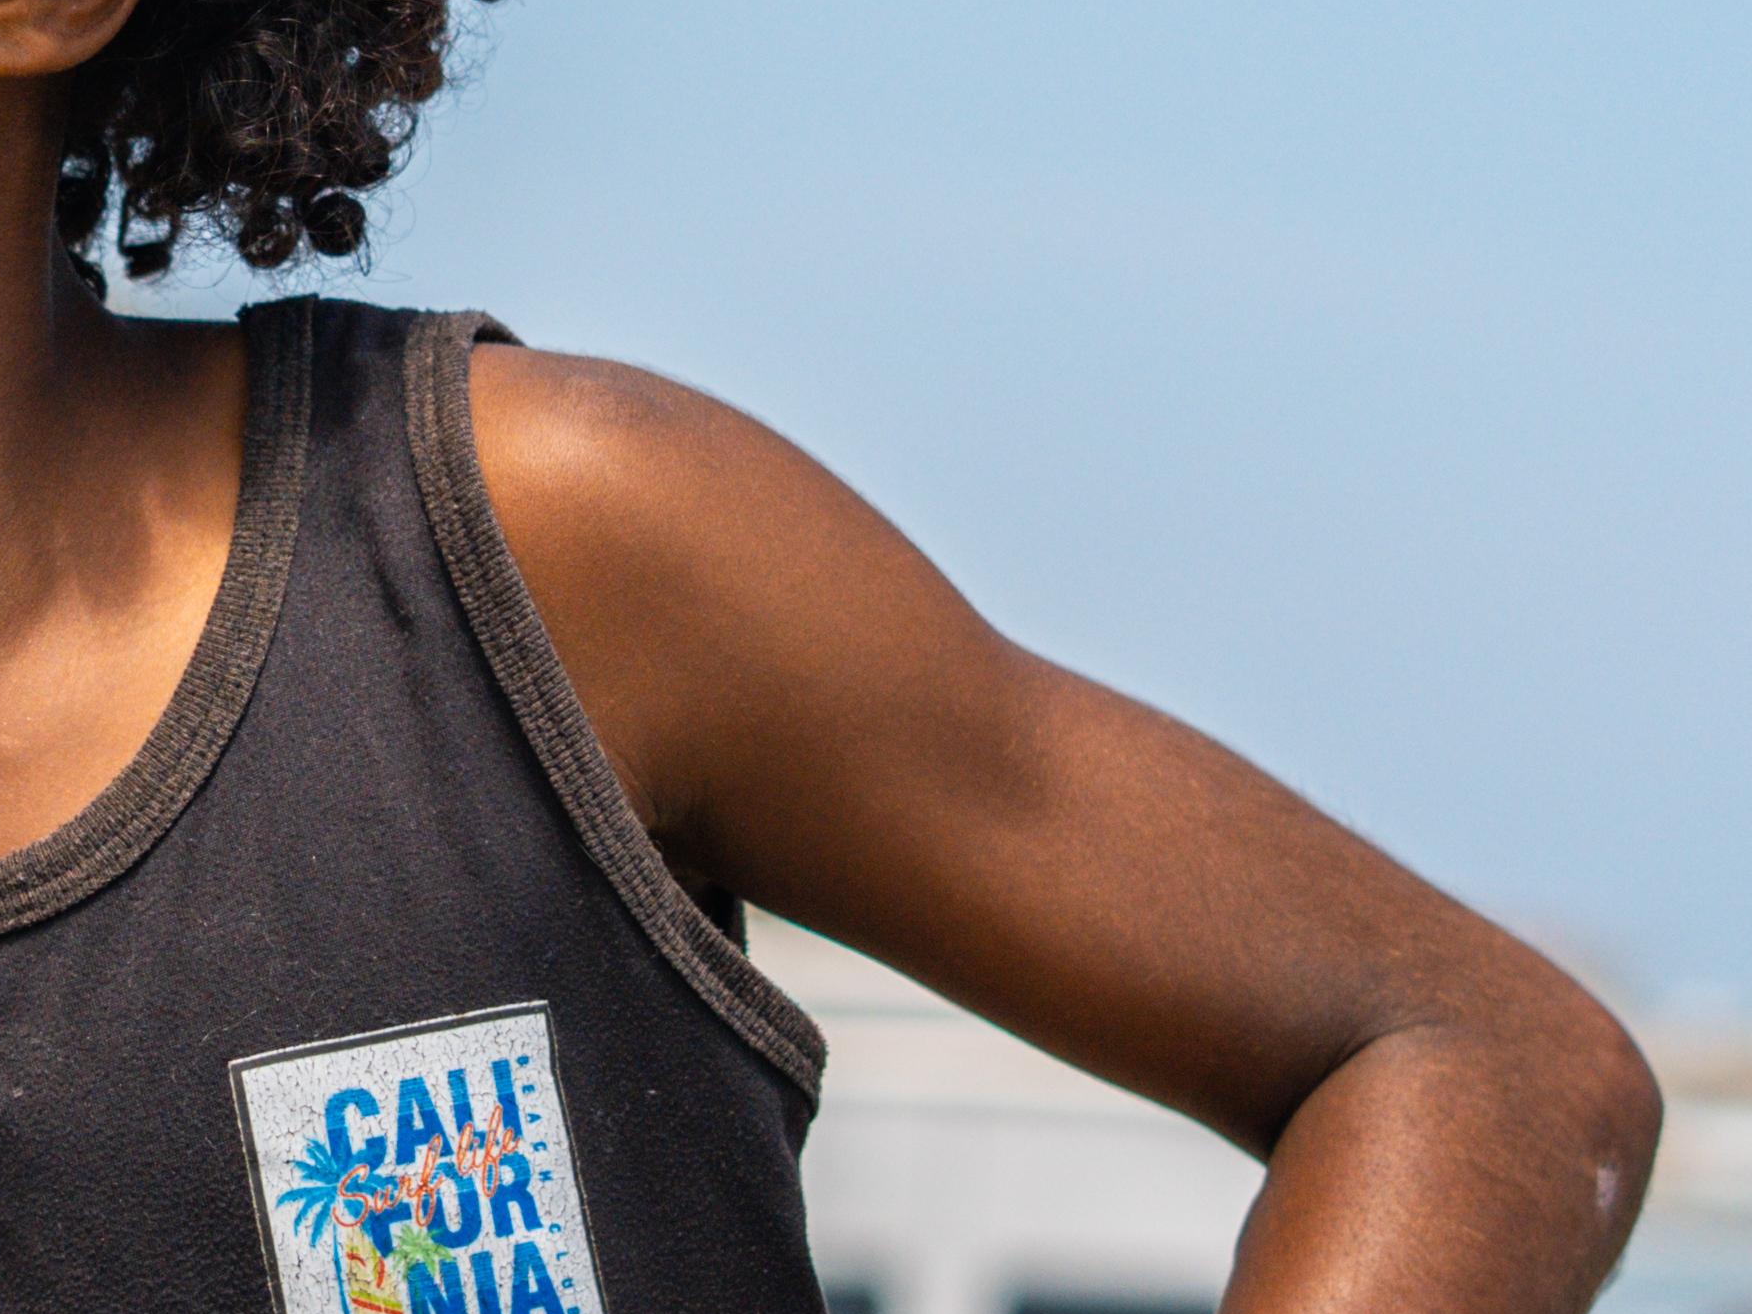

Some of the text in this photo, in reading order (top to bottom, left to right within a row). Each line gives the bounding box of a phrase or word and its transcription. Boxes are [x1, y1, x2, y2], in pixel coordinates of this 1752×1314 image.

[325, 1058, 522, 1167] CALI
[331, 1105, 521, 1227] Surf life
[516, 1055, 553, 1183] BEACH
[369, 1154, 543, 1257] FOR
